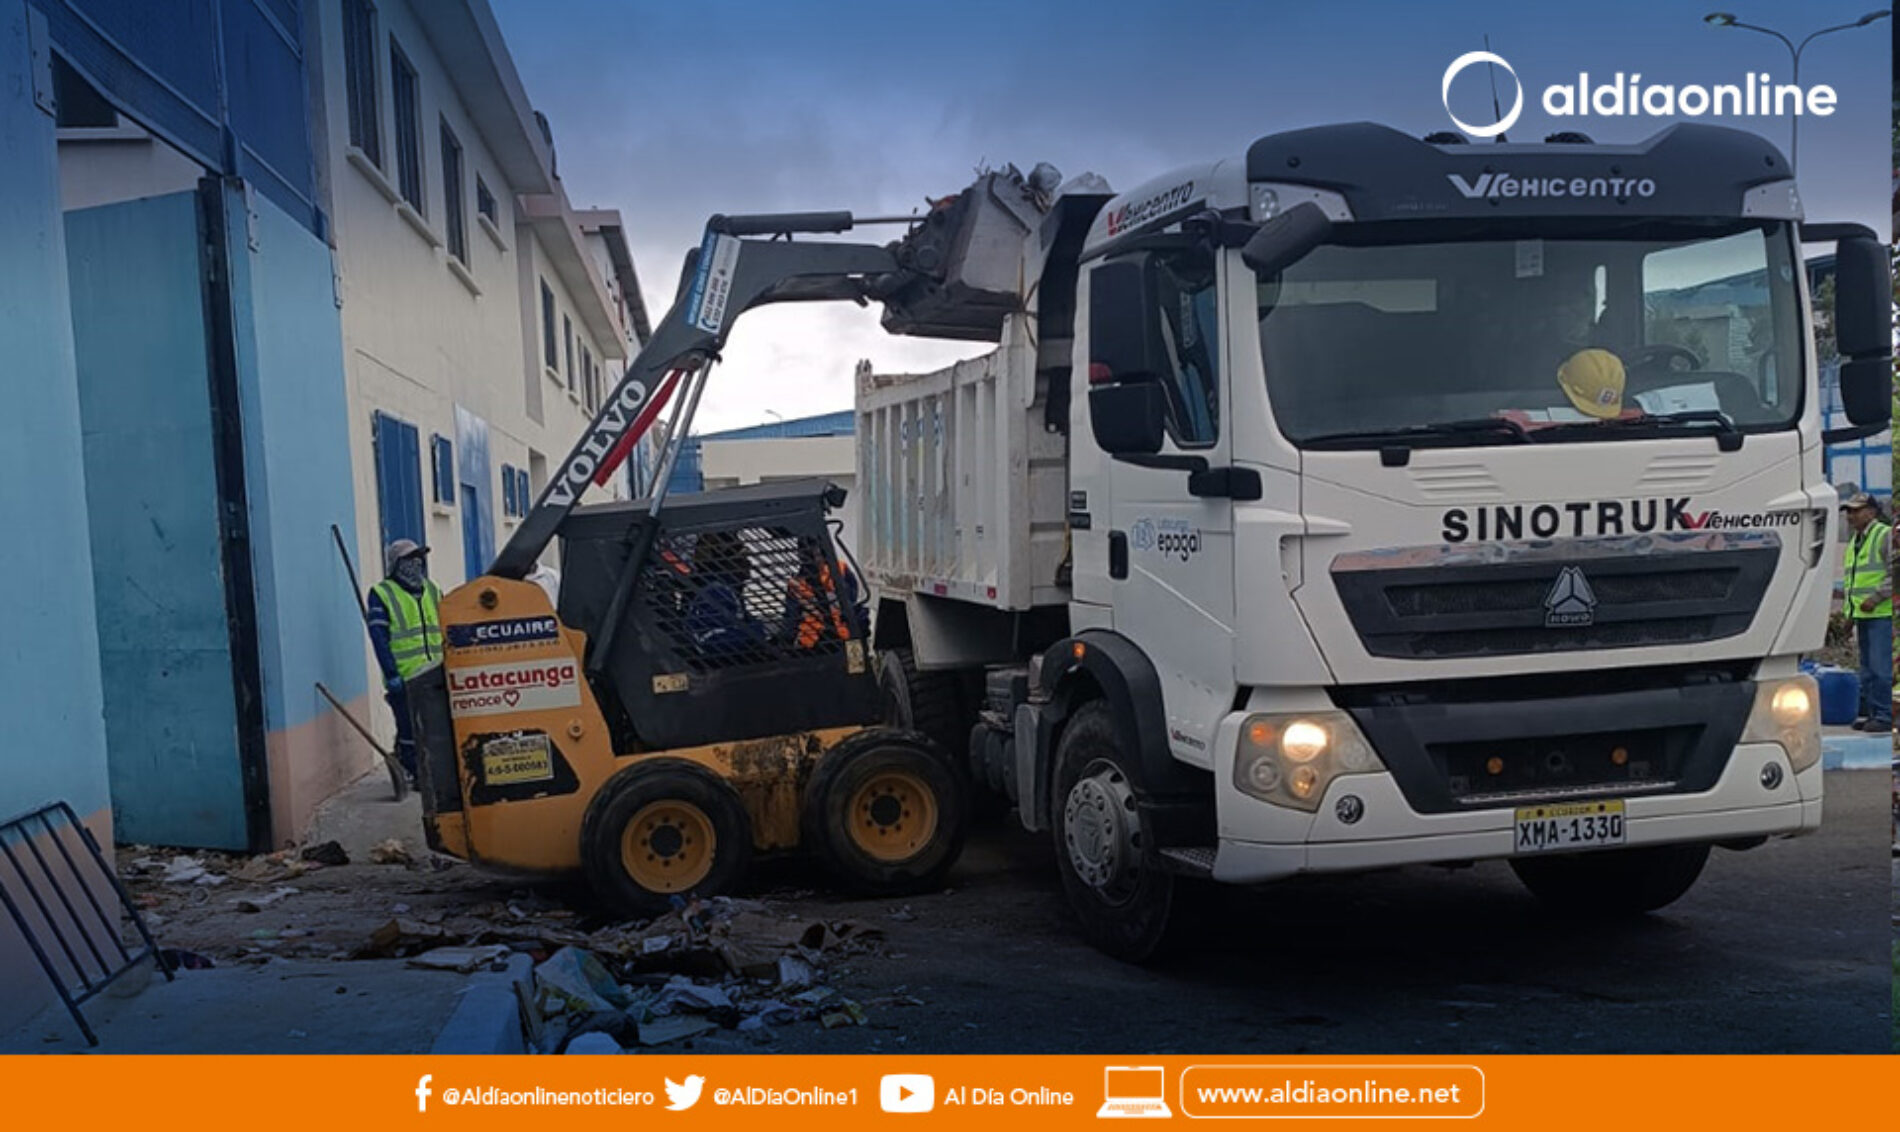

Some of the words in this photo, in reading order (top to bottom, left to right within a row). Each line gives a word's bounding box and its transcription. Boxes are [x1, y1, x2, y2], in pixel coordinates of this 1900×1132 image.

[543, 379, 646, 507] VOLVO
[1442, 497, 1691, 543] SINOTRUK
[450, 665, 575, 691] Latacunga
[453, 695, 501, 711] renace
[1519, 814, 1622, 846] XMA-1330
